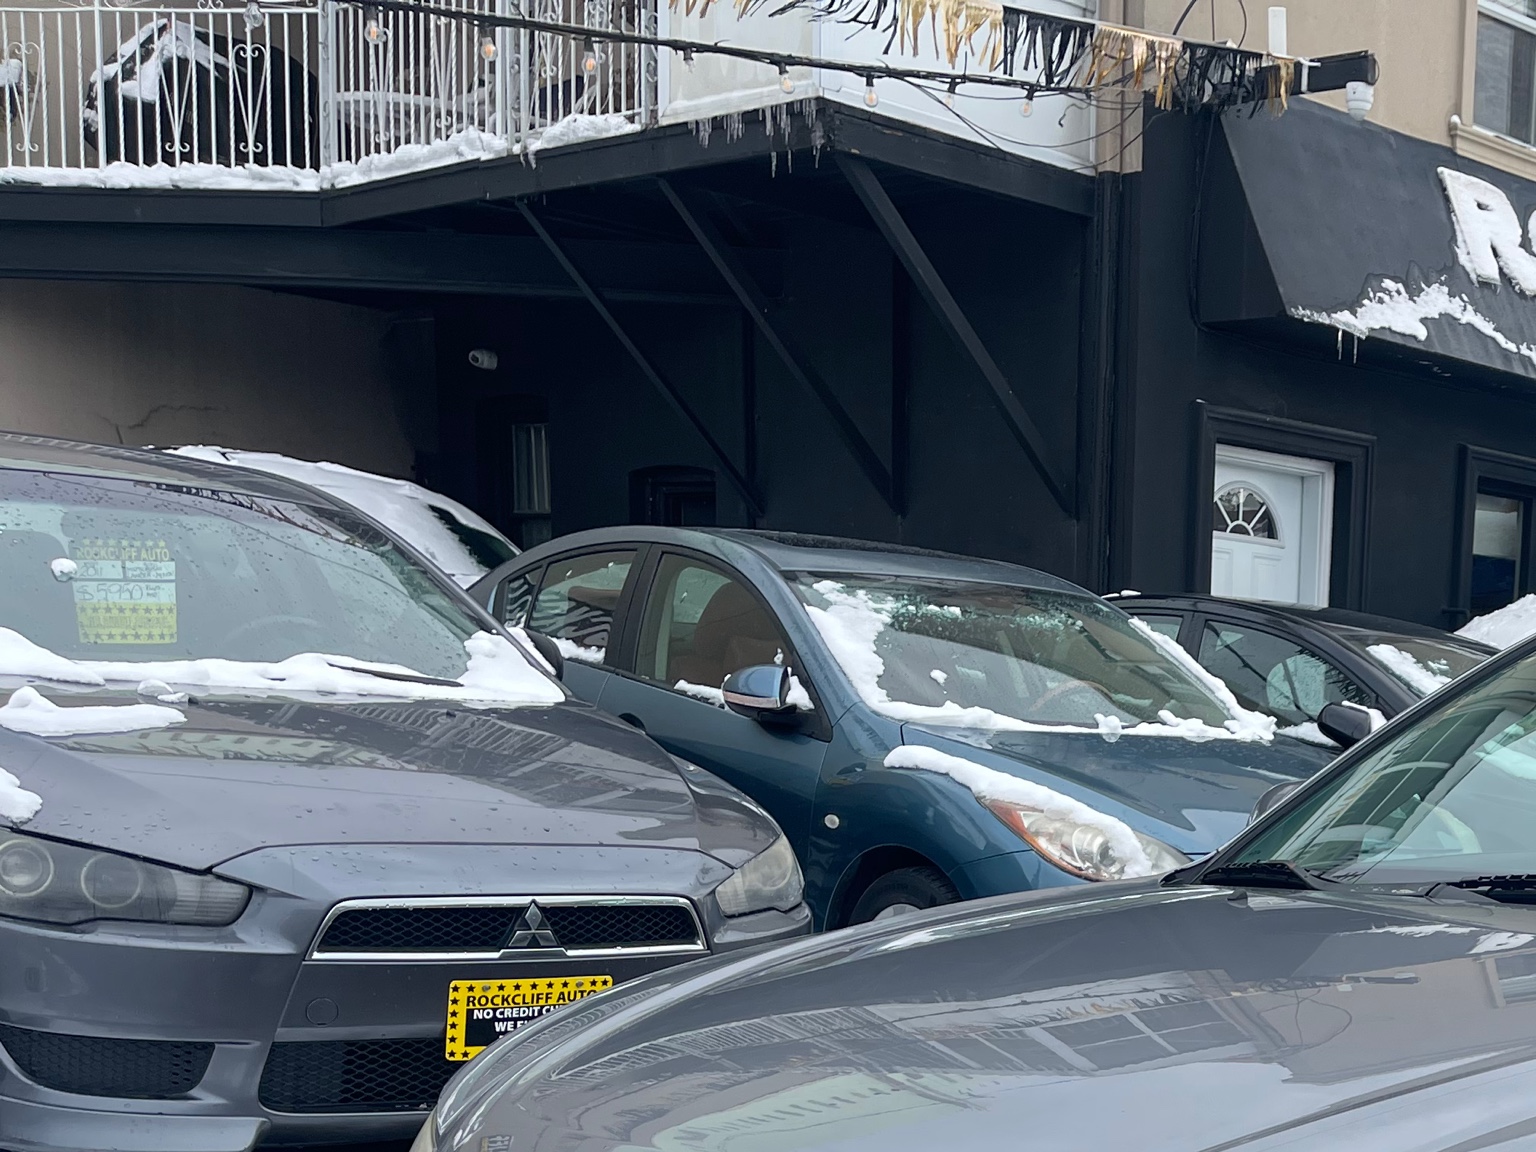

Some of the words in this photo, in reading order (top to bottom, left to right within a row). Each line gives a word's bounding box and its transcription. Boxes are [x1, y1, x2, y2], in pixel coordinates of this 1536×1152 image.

[141, 549, 170, 561] AUTO
[466, 992, 552, 1008] ROCKCLIFF
[473, 1009, 493, 1019] NO
[496, 1006, 541, 1018] CREDIT
[495, 1021, 514, 1032] WE
